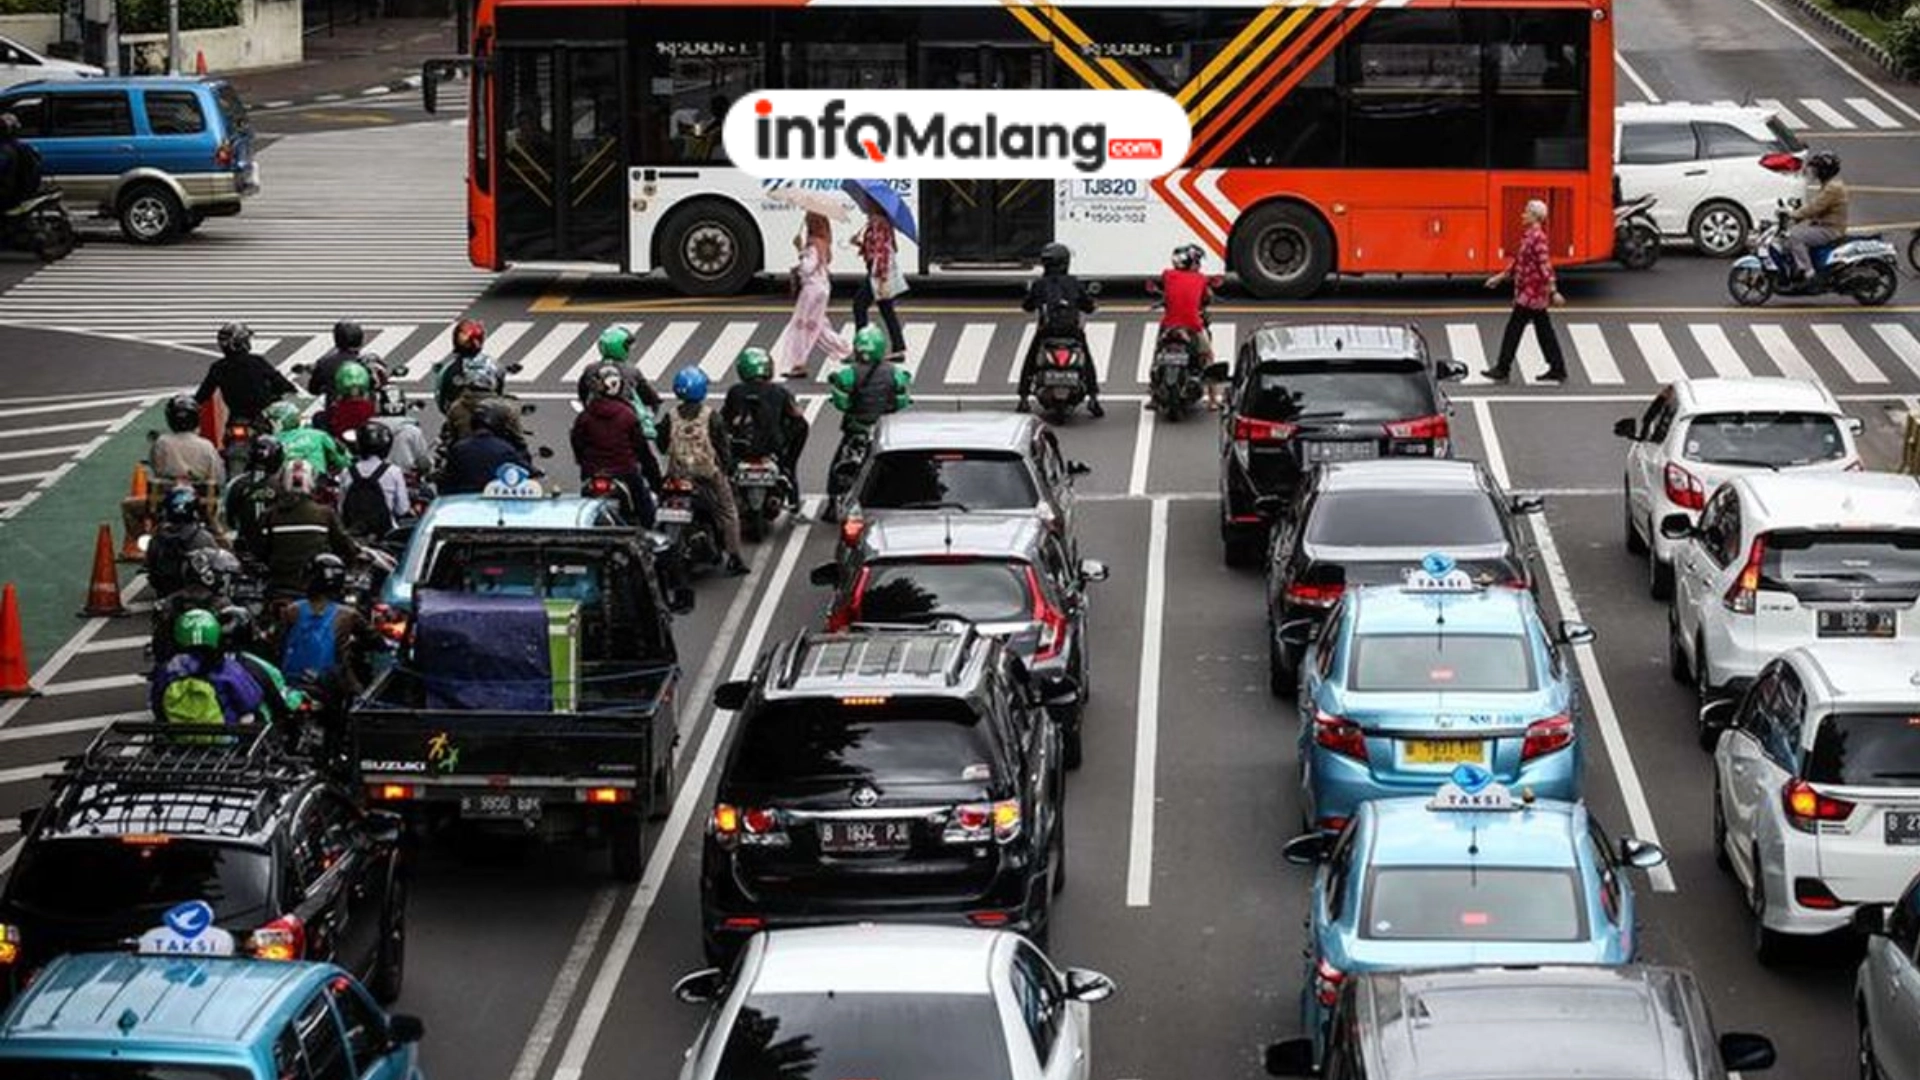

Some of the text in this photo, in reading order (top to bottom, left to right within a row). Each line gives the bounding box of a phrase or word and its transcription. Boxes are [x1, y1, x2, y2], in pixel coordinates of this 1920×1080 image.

[1080, 179, 1137, 195] TJ820
[360, 760, 426, 771] SUZUKI
[1447, 795, 1501, 805] TAKSI
[1888, 813, 1899, 831] B
[154, 938, 217, 953] TAKSI
